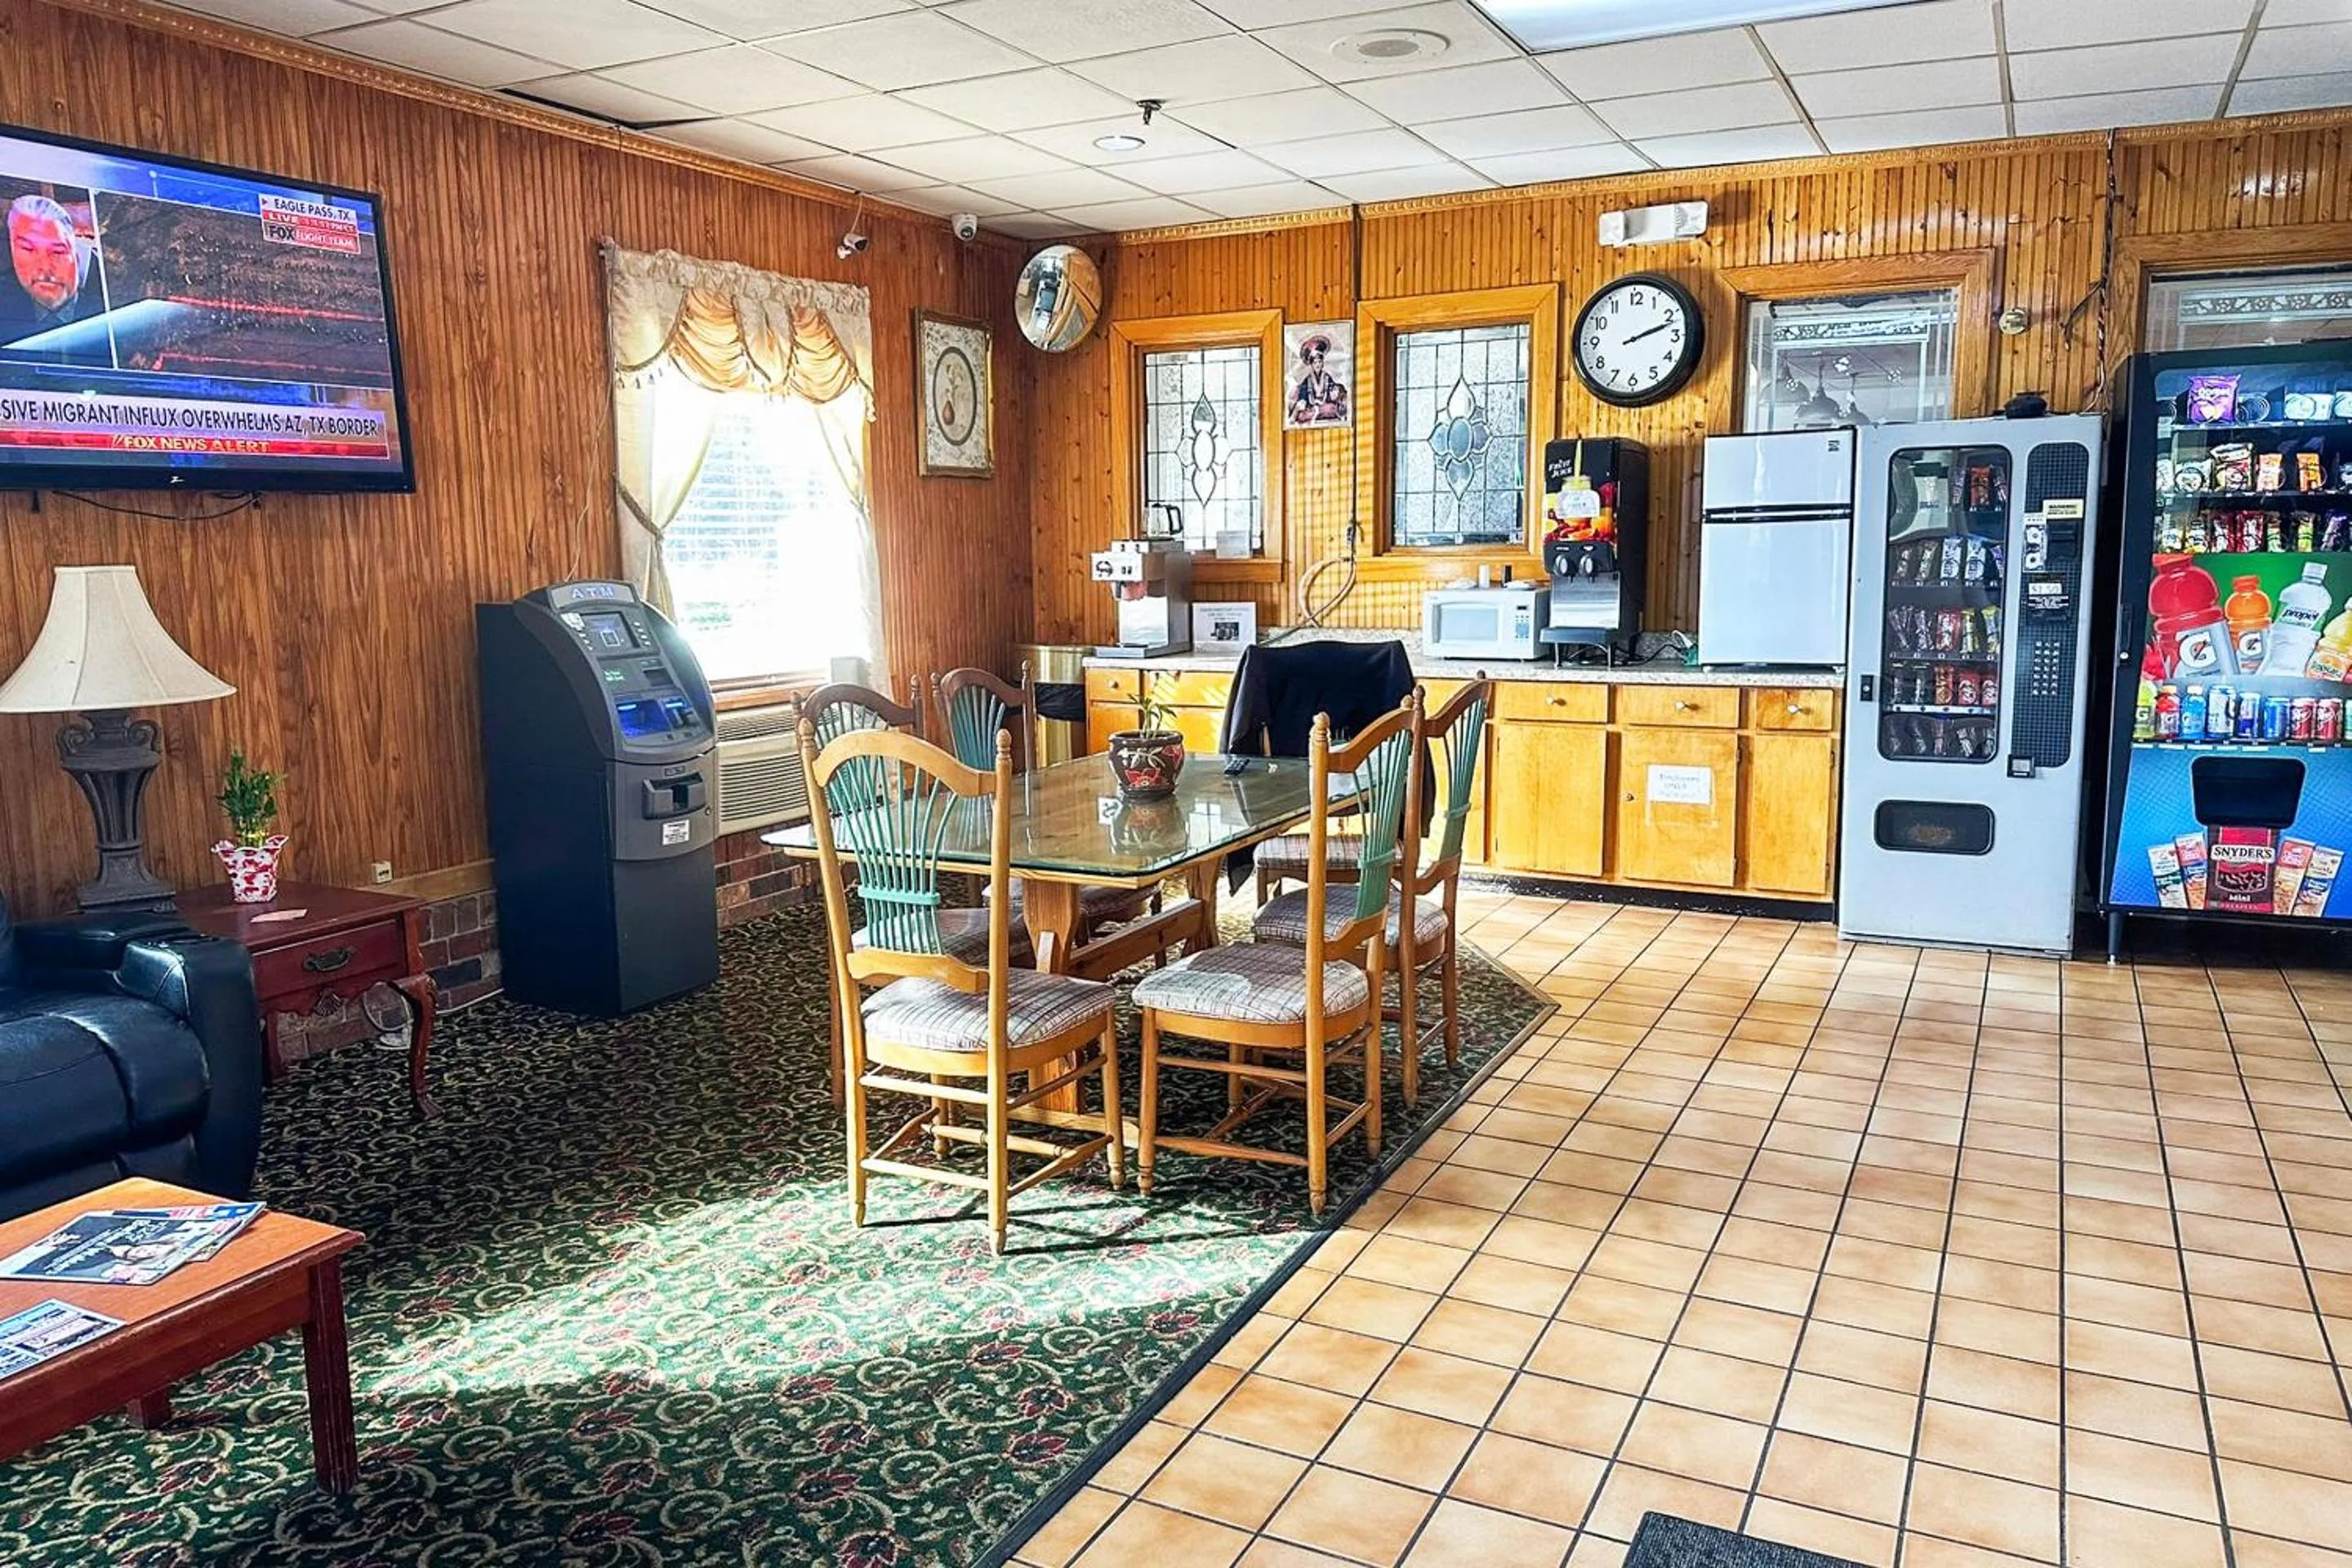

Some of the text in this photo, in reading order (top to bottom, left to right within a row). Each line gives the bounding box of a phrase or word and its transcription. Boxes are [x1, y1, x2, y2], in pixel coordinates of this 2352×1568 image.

[274, 198, 305, 214] EAGLE
[337, 209, 351, 221] TX
[269, 212, 299, 223] LIVE
[268, 225, 295, 241] FOX
[1630, 291, 1644, 306] 12
[1651, 296, 1656, 310] 1
[1610, 300, 1619, 314] 11
[1664, 308, 1674, 323] 2
[1595, 316, 1607, 331] 10
[1589, 336, 1600, 350] 9
[1670, 328, 1681, 343] 3
[1595, 355, 1606, 369] 8
[1663, 350, 1673, 363] 4
[1611, 369, 1621, 384] 7
[1628, 372, 1638, 387] 6
[1648, 366, 1659, 381] 5
[0, 399, 378, 437] SIVE MIGRANT INFLUX OVERWHELMS AZ, TX BORDER
[123, 435, 271, 453] FOX NEWS ALERT
[572, 586, 615, 599] ATM
[2213, 846, 2273, 859] SNYDER'S
